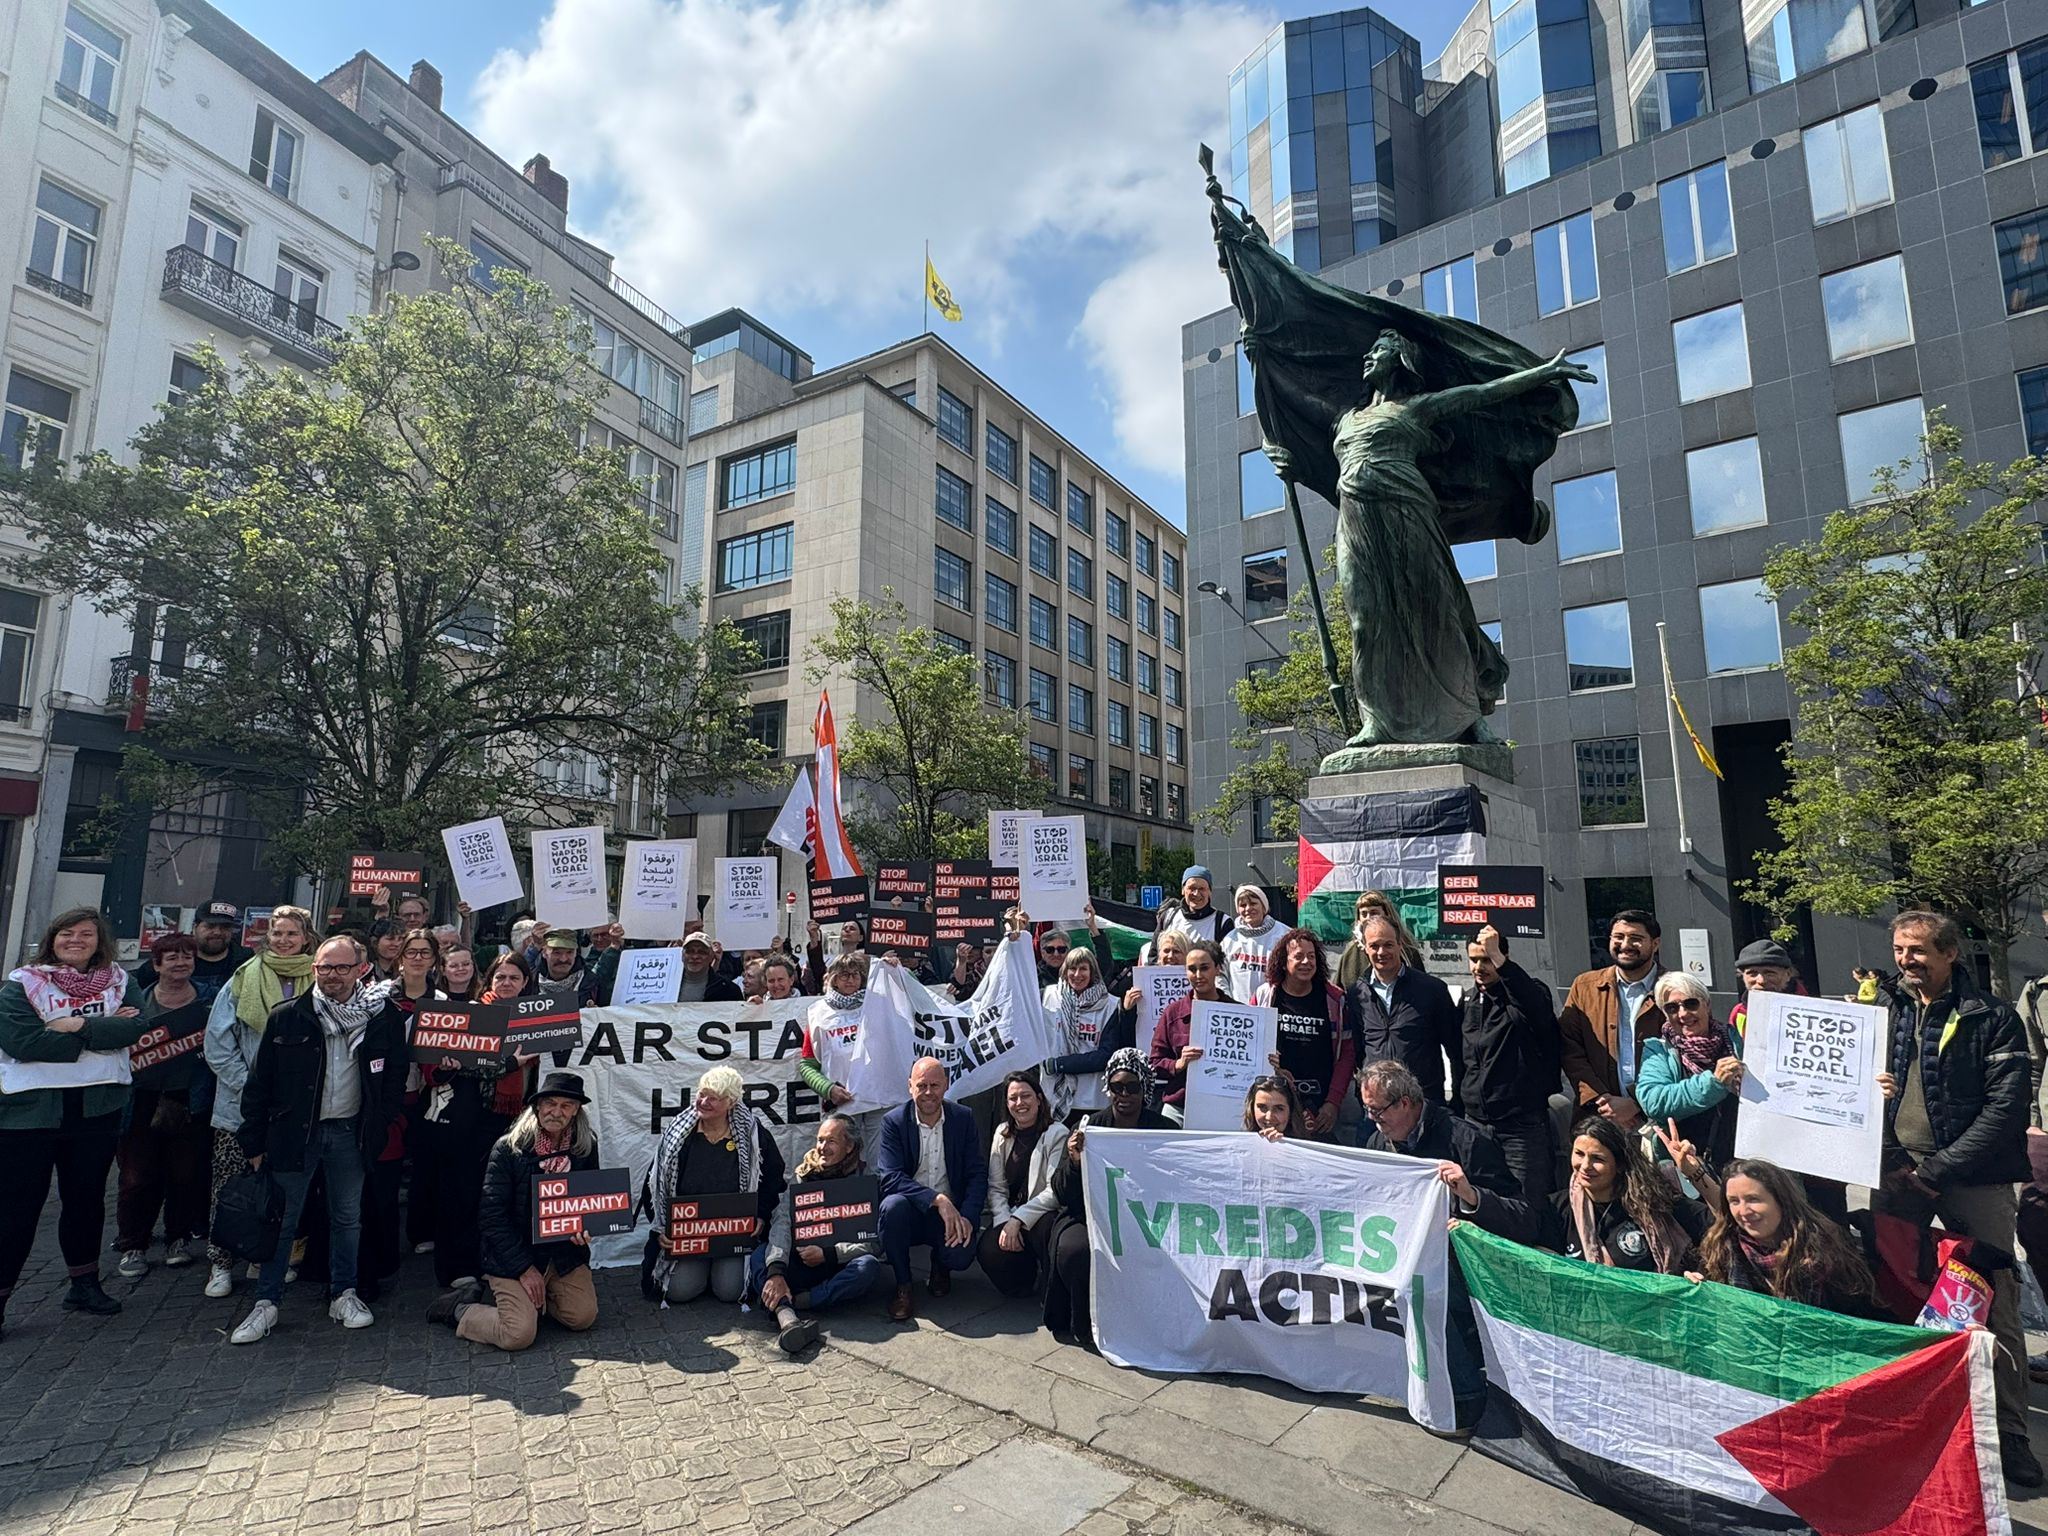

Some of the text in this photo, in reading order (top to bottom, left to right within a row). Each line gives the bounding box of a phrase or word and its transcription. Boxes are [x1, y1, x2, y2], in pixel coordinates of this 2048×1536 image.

[459, 832, 490, 847] STOP
[1003, 832, 1018, 840] VO
[1034, 828, 1067, 839] STOP
[551, 838, 587, 849] STOP
[1035, 845, 1068, 854] VOOR
[463, 846, 494, 859] VOOR
[1035, 854, 1069, 863] ISRAEL
[353, 858, 373, 868] NO
[465, 854, 495, 866] ISRAEL
[552, 854, 588, 866] VOOR
[552, 863, 588, 875] ISRAEL
[731, 866, 763, 876] STOP
[880, 869, 906, 879] STOP
[937, 865, 951, 874] NO
[352, 870, 417, 881] HUMANITY
[936, 876, 987, 887] HUMANITY
[991, 876, 1019, 887] STOP
[351, 883, 382, 893] LEFT
[735, 881, 759, 889] FOR
[879, 881, 926, 892] IMPUNITY
[1444, 877, 1478, 888] GEEN
[731, 889, 763, 897] ISRAEL
[811, 887, 832, 896] GEEN
[936, 888, 959, 898] LEFT
[812, 894, 865, 906] WAPENS NAAR
[1444, 893, 1535, 907] WAPENS NAAR
[937, 907, 959, 915] GEEN
[872, 918, 904, 930] STOP
[936, 918, 994, 928] WAPENS NAAR
[871, 933, 929, 947] IMPUNITY
[1154, 978, 1190, 989] STOP
[519, 999, 555, 1014] STOP
[421, 1013, 466, 1028] STOP
[1211, 1014, 1254, 1029] STOP
[1786, 1012, 1857, 1035] STOP
[1280, 1022, 1320, 1035] ISRAEL
[416, 1031, 500, 1051] IMPUNITY
[1215, 1037, 1247, 1050] FOR
[1785, 1029, 1856, 1049] WEAPONS
[130, 1032, 203, 1071] MPUNIT
[1209, 1048, 1252, 1061] ISRAEL
[1793, 1042, 1845, 1062] FOR
[1784, 1055, 1854, 1078] ISRAEL
[651, 1080, 820, 1135] HRE
[540, 1182, 565, 1197] NO
[541, 1195, 624, 1214] HUMANITY
[795, 1192, 824, 1206] GEEN
[673, 1204, 696, 1219] NO
[796, 1203, 872, 1223] WAPENS NAAR
[542, 1218, 580, 1233] LEFT
[673, 1218, 751, 1235] HUMANITY
[1127, 1199, 1399, 1273] VREDES
[672, 1239, 707, 1253] LEFT
[1209, 1268, 1406, 1338] ACTIE
